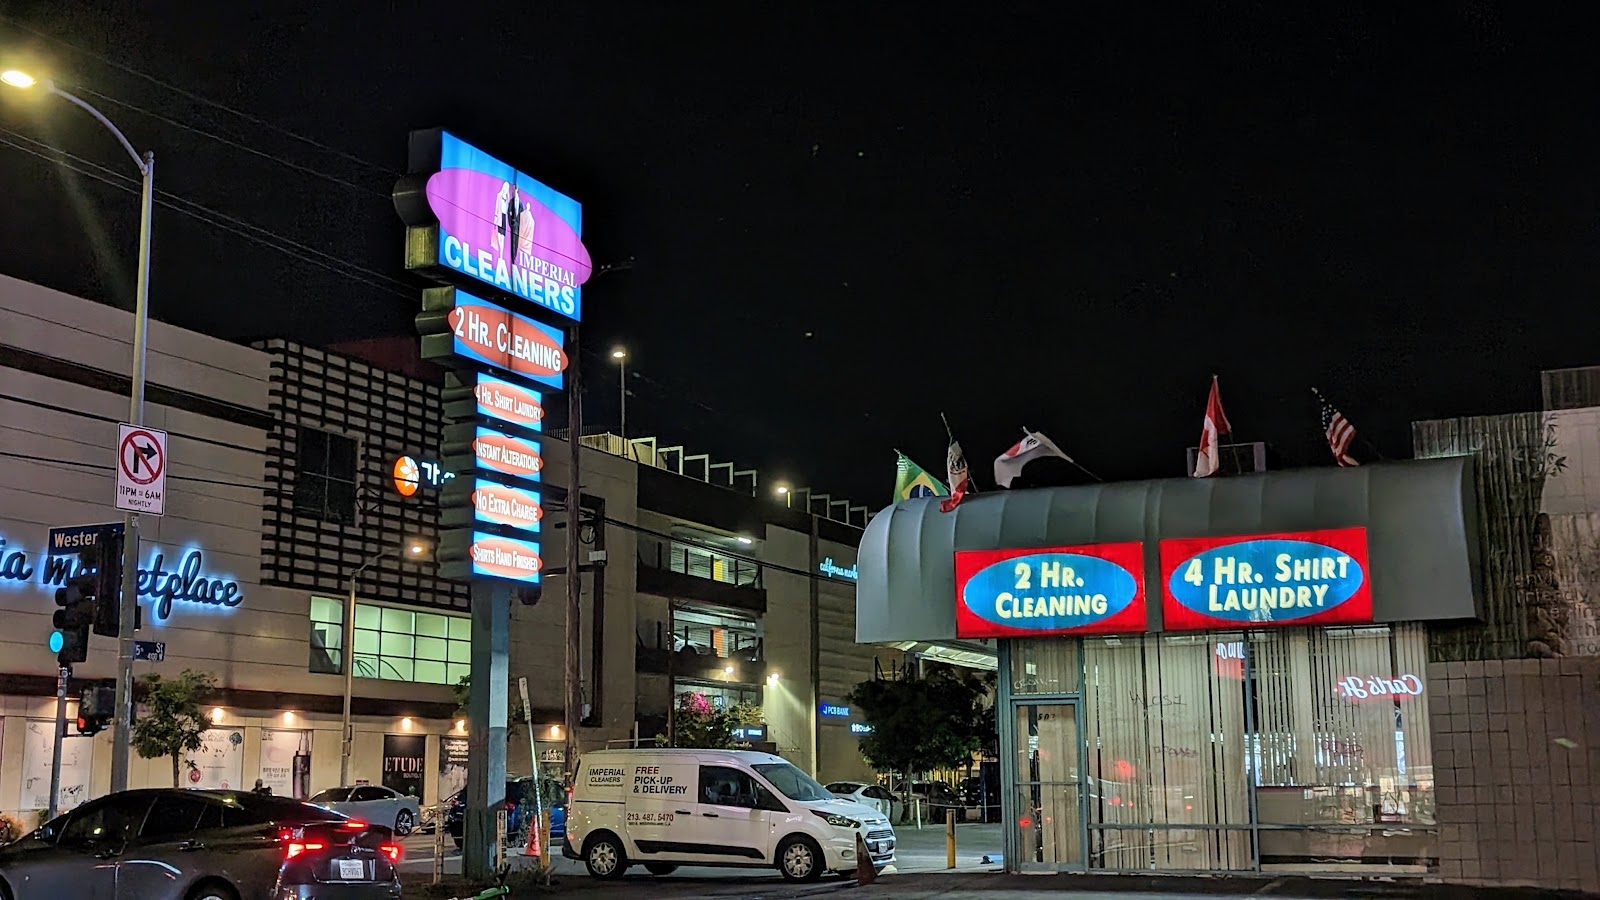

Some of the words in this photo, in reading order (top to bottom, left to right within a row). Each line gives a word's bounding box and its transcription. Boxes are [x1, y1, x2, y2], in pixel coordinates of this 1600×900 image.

[444, 235, 575, 315] CLEANERS
[518, 250, 578, 289] IMPERIAL
[455, 306, 464, 338] 2
[496, 322, 562, 372] CLEANING
[494, 392, 513, 412] SHIRT
[513, 396, 542, 421] LAUNDRY
[475, 438, 501, 461] INSTANT
[501, 445, 539, 472] ALTERATIONS
[119, 485, 136, 497] 11PM
[144, 490, 161, 501] 6AM
[128, 499, 152, 508] NIGHTLY
[475, 490, 487, 510] NO
[488, 493, 510, 515] EXTRA
[511, 499, 538, 521] CHARGE
[54, 530, 99, 548] Wester
[473, 544, 495, 565] SHIRTS
[495, 547, 512, 567] HAND
[512, 551, 539, 571] FINISHED
[1183, 557, 1204, 587] 4
[1274, 552, 1351, 583] SHIRT
[1013, 562, 1031, 590] 2
[994, 591, 1108, 620] CLEANING
[1207, 583, 1330, 613] LAUNDRY
[155, 642, 163, 654] St
[827, 706, 837, 716] PCB
[837, 706, 850, 717] BANK
[385, 756, 423, 772] ETUDE
[589, 768, 626, 776] IMPERIAL
[635, 766, 660, 775] FREE
[633, 785, 640, 794] &
[642, 786, 688, 795] DELIVERY
[634, 776, 673, 785] PICK-UP
